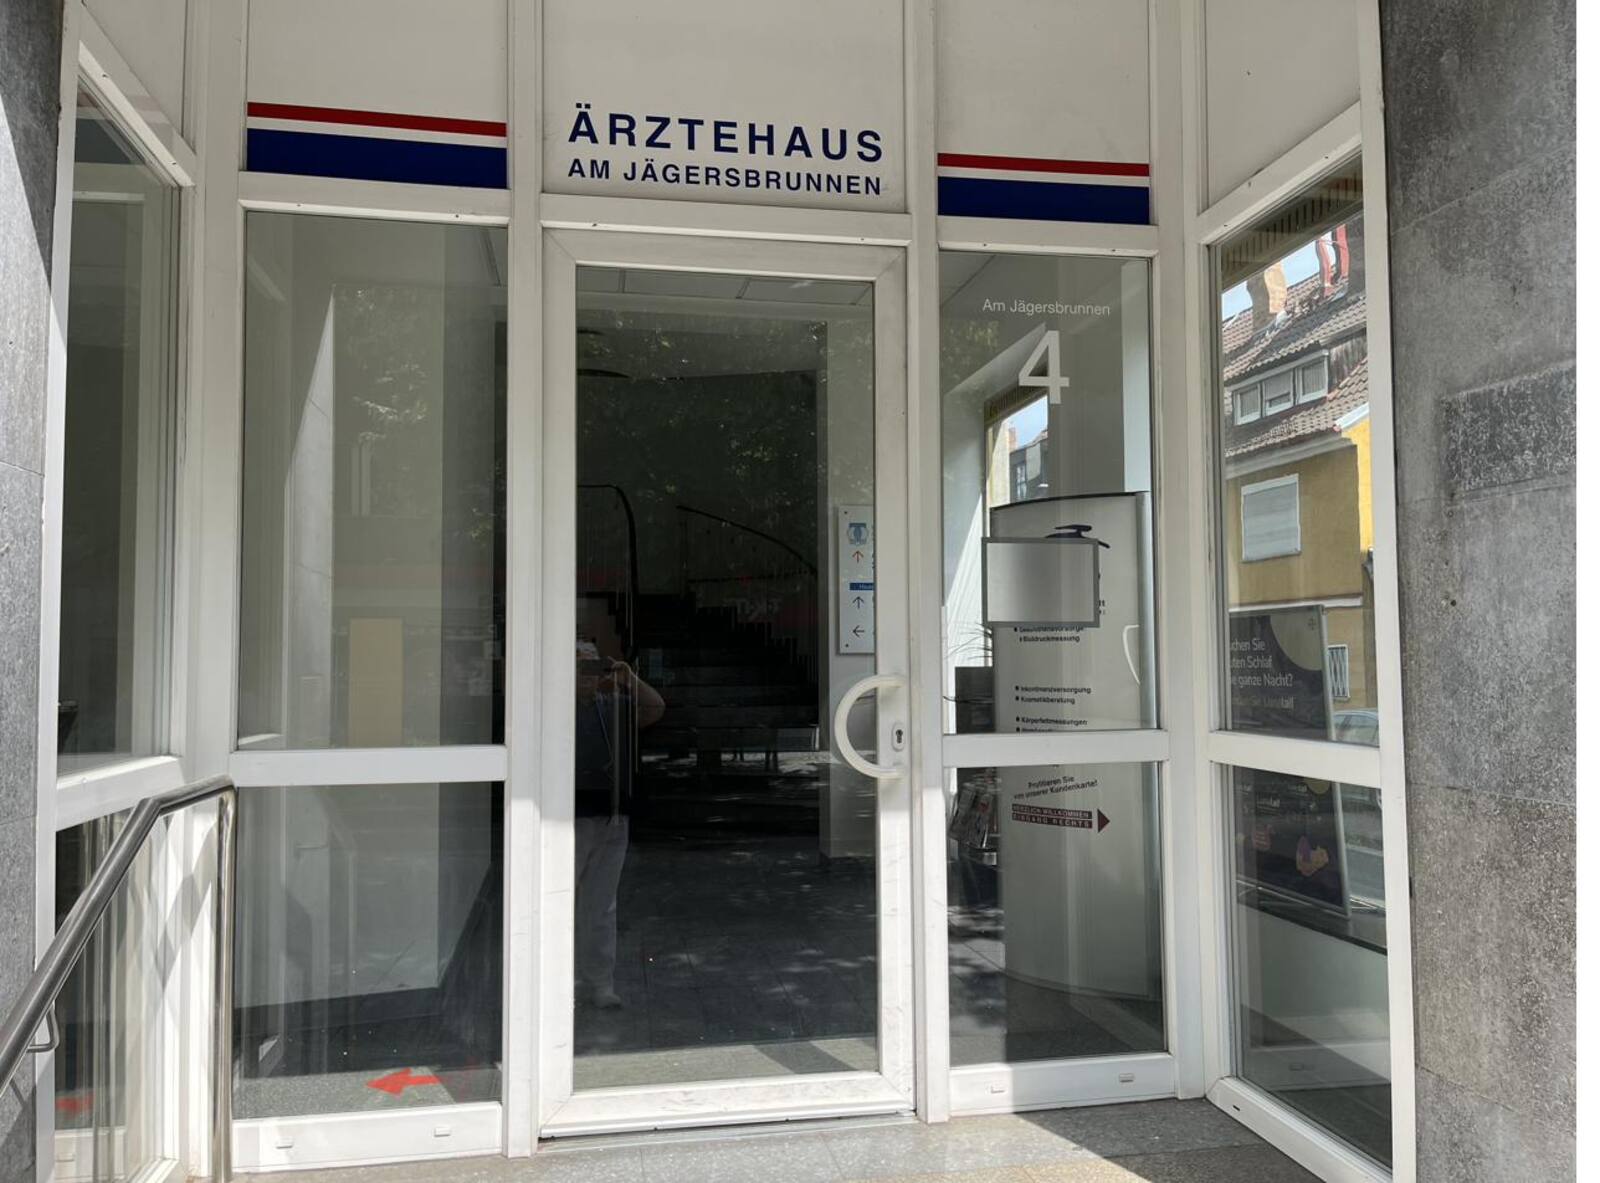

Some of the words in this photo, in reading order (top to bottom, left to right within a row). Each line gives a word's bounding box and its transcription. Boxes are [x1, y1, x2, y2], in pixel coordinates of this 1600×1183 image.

[568, 103, 883, 162] ÄRZTEHAUS
[568, 158, 610, 179] AM
[623, 158, 881, 195] JÄGERSBRUNNEN
[983, 299, 1006, 312] Am
[1010, 300, 1110, 317] Jägersbrunnen
[1019, 330, 1070, 404] 4
[1252, 638, 1266, 651] Sie
[1246, 655, 1273, 669] Schlaf
[1238, 676, 1262, 688] ganze
[1263, 673, 1293, 687] Nacht?
